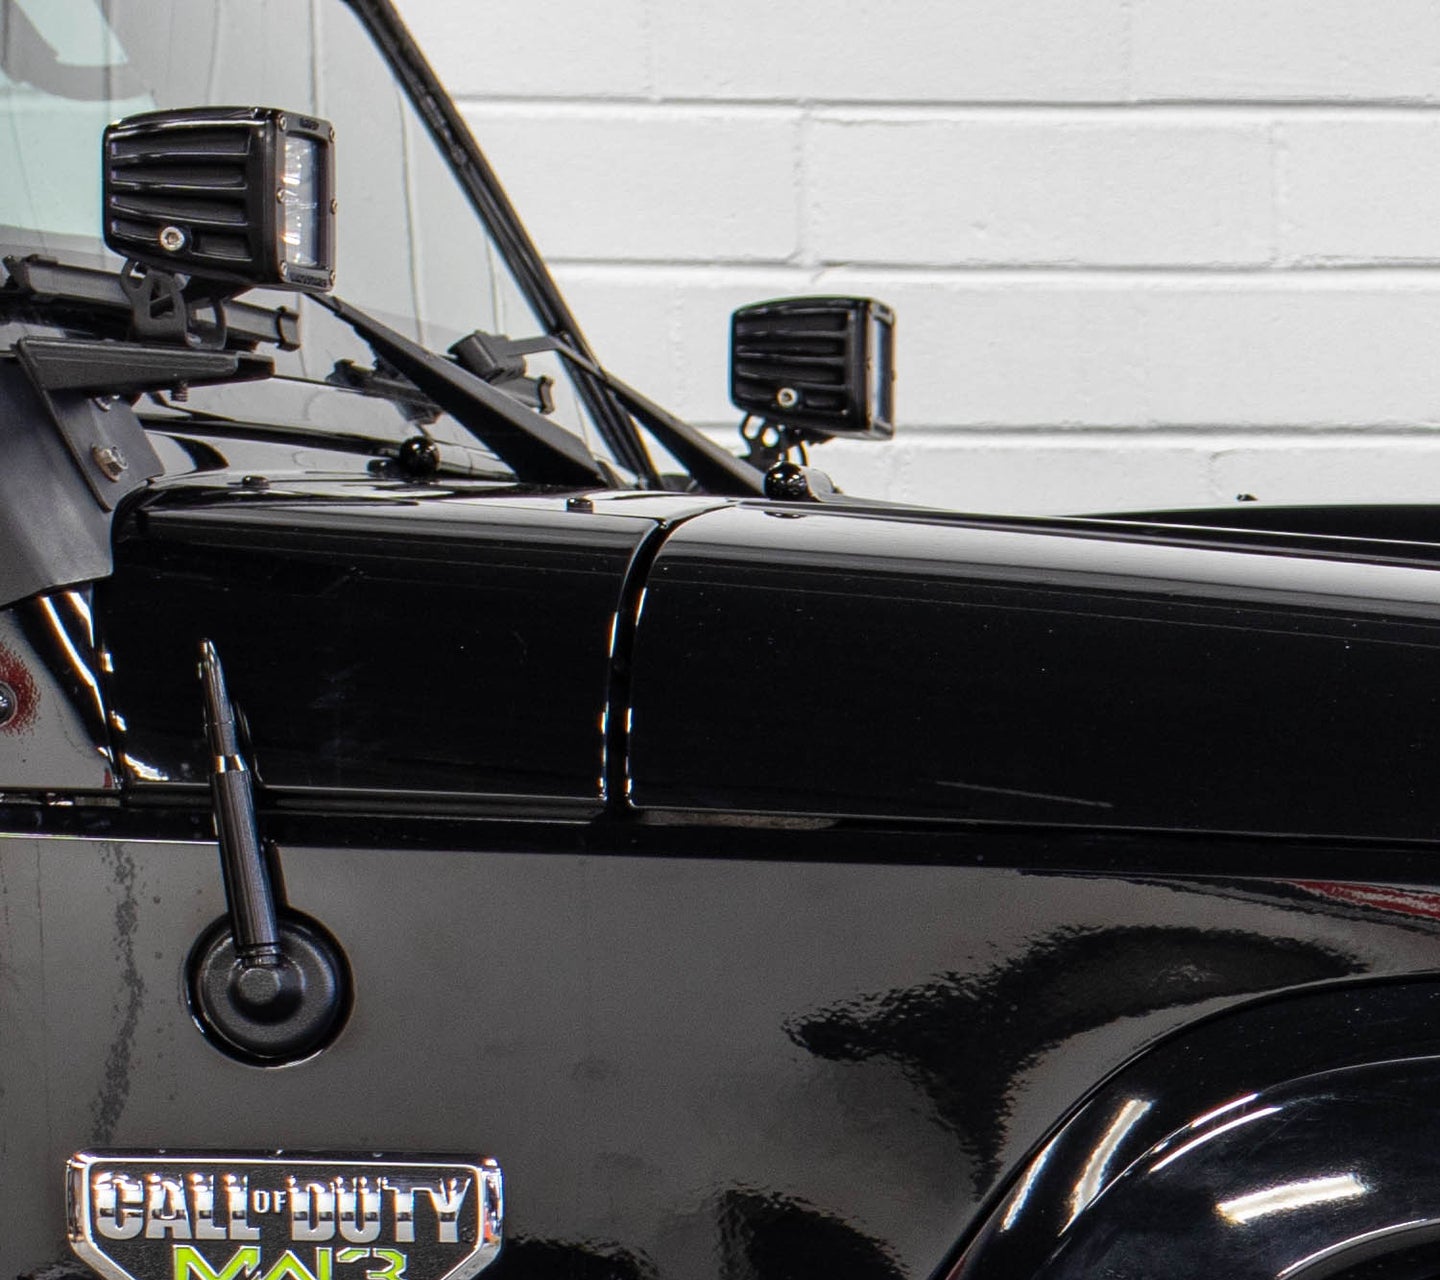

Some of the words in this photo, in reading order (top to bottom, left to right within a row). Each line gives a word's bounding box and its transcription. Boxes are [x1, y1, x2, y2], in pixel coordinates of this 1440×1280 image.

[93, 1172, 260, 1240] CALL
[254, 1190, 285, 1213] OF
[289, 1175, 471, 1243] DUTY
